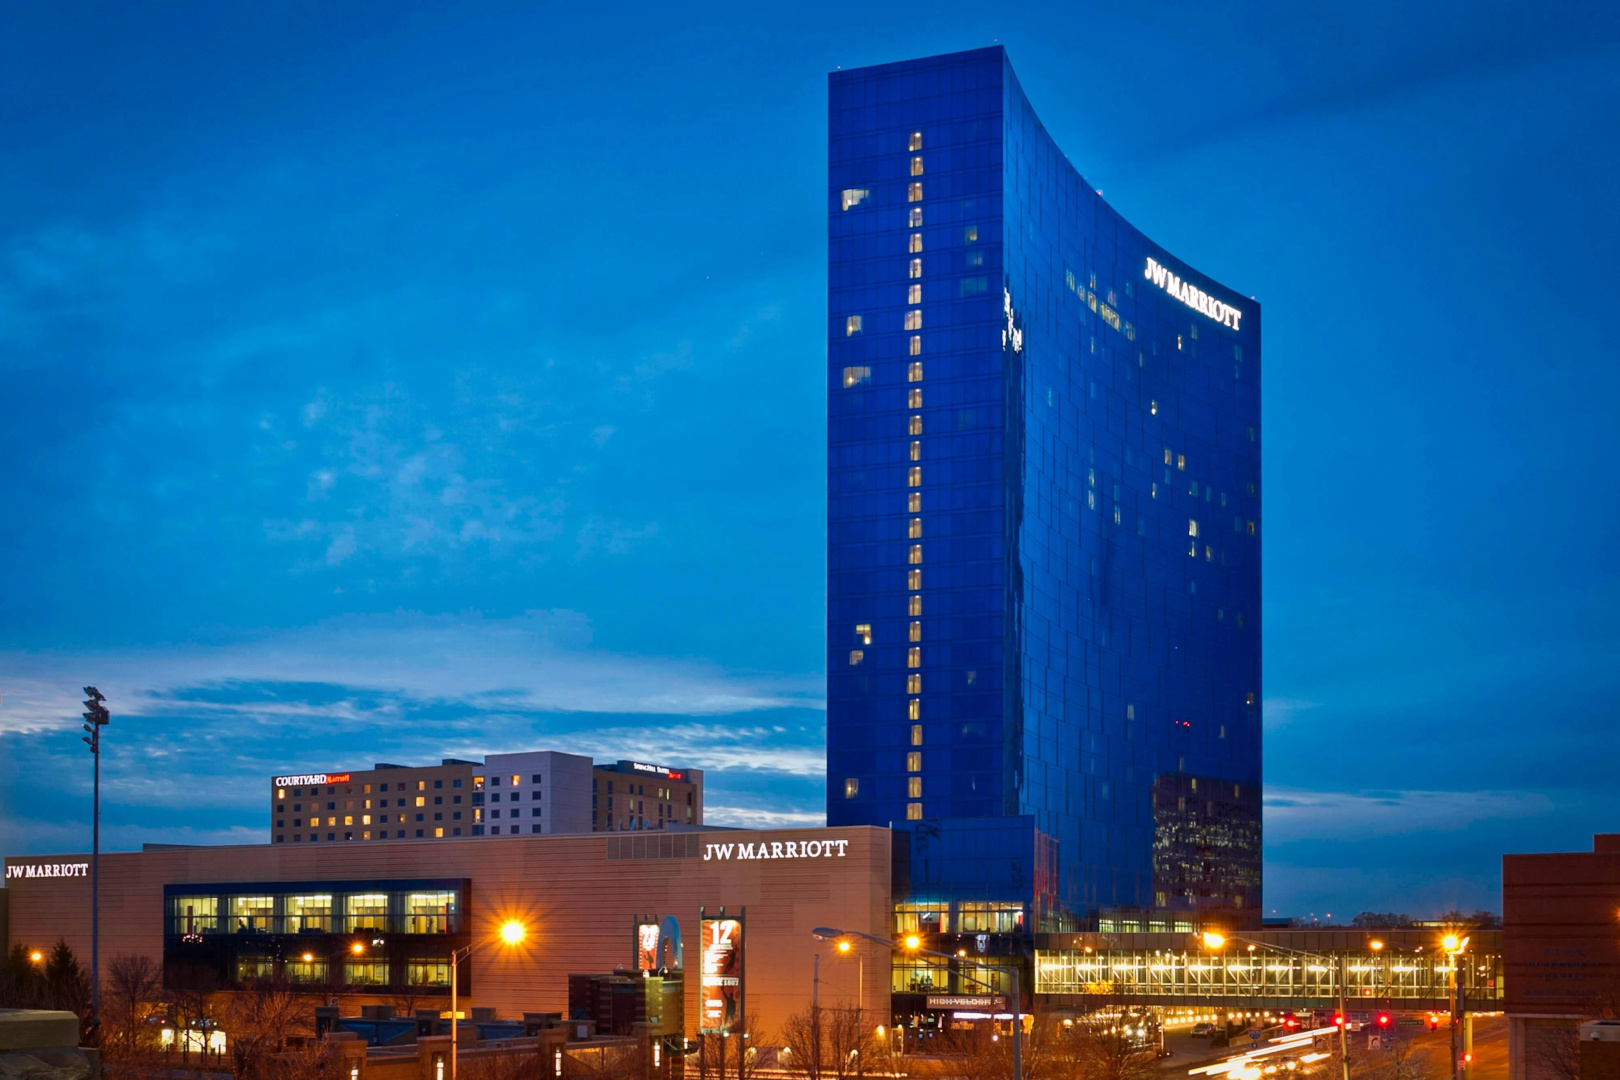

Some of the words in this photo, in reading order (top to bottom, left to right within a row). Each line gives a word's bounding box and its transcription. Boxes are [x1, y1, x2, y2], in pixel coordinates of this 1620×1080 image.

[1144, 257, 1168, 289] JW
[1166, 271, 1242, 331] MARRIOTT
[276, 774, 326, 786] COURTYARD
[703, 843, 735, 861] JW
[736, 840, 849, 860] MARRIOTT
[5, 865, 24, 879] JW
[25, 863, 89, 878] MARRIOTT
[709, 920, 733, 944] 12
